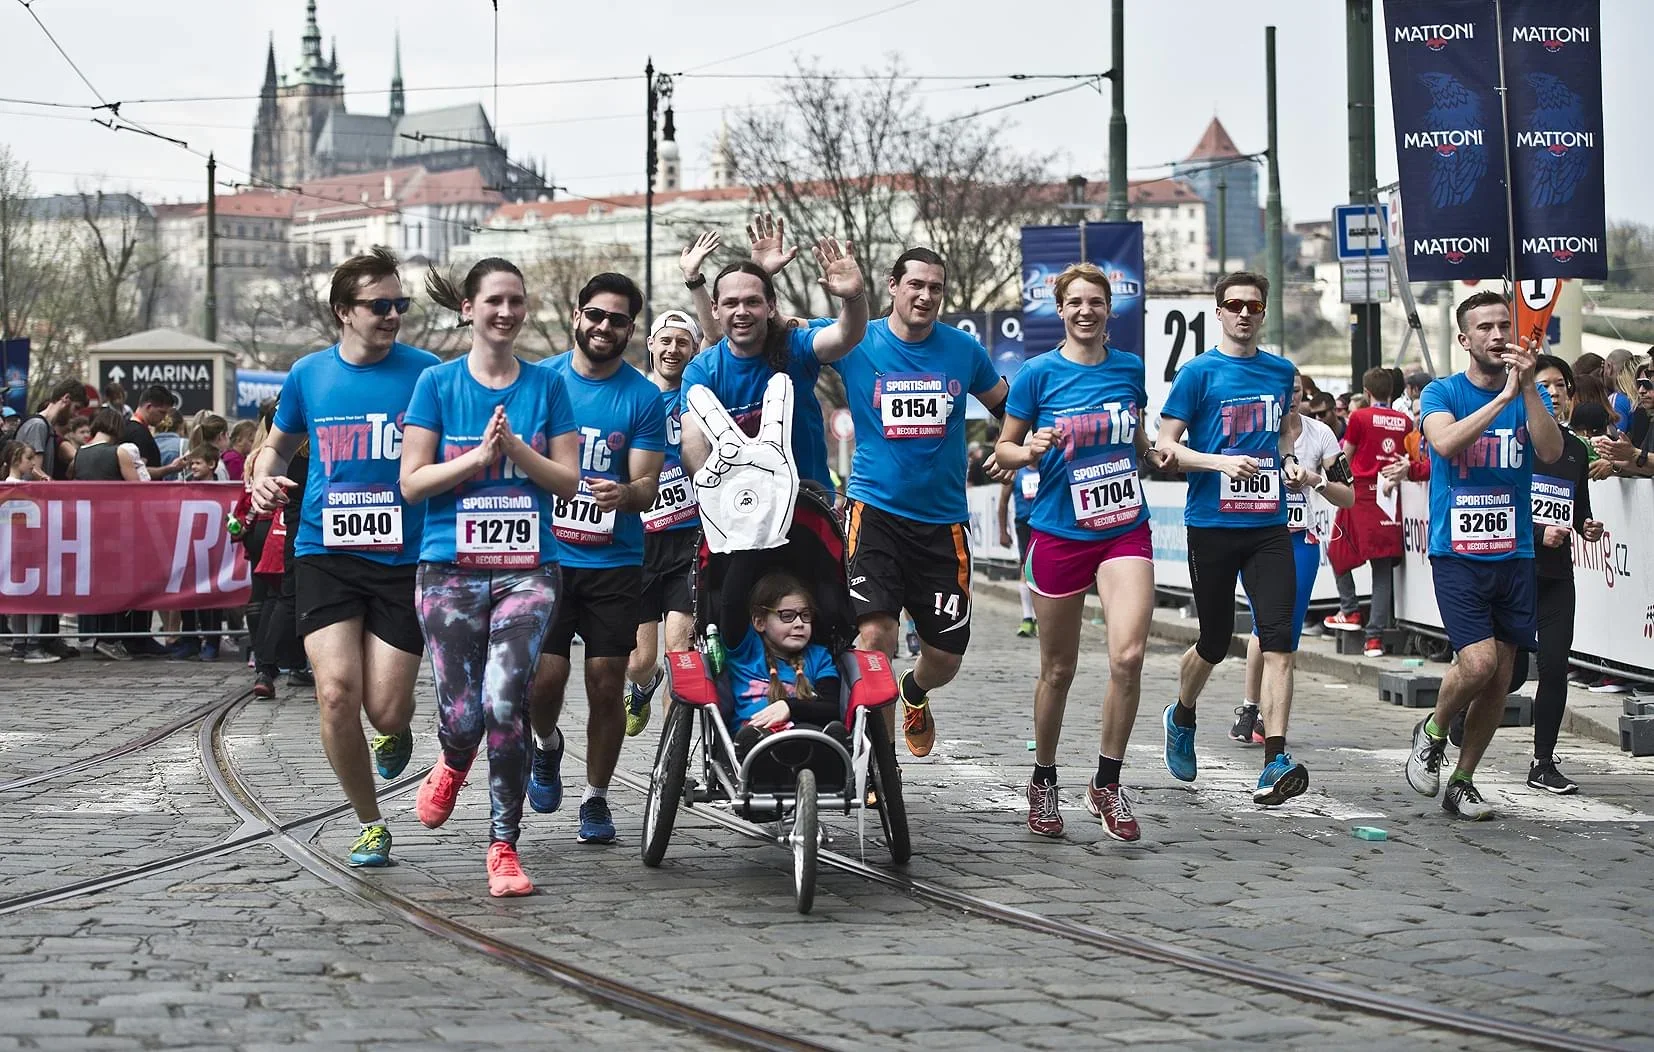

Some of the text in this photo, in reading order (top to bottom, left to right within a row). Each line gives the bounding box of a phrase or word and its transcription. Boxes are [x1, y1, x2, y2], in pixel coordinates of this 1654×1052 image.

[1395, 23, 1474, 42] MATTONI
[1512, 26, 1590, 42] MATTONI
[1404, 130, 1483, 149] MATTONI
[1516, 131, 1594, 148] MATTONI
[1413, 237, 1490, 256] MATTONI
[1522, 237, 1598, 254] MATTONI
[1164, 310, 1205, 383] 21
[132, 365, 210, 382] MARINA
[892, 398, 938, 418] 8154
[896, 427, 919, 435] RECODE
[1230, 474, 1271, 493] 5160
[1080, 478, 1136, 511] F1704
[555, 497, 603, 525] 8170
[1234, 502, 1277, 510] RECODE RUNNING
[1531, 498, 1571, 522] 2268
[333, 512, 392, 537] 5040
[653, 516, 675, 529] RECODE
[1093, 514, 1117, 527] RECODE
[1460, 511, 1508, 533] 3266
[466, 519, 531, 544] F1279
[556, 529, 580, 540] RECODE
[1404, 517, 1429, 566] erop
[1467, 542, 1489, 551] RECODE
[475, 555, 535, 565] RECODE RUNNING
